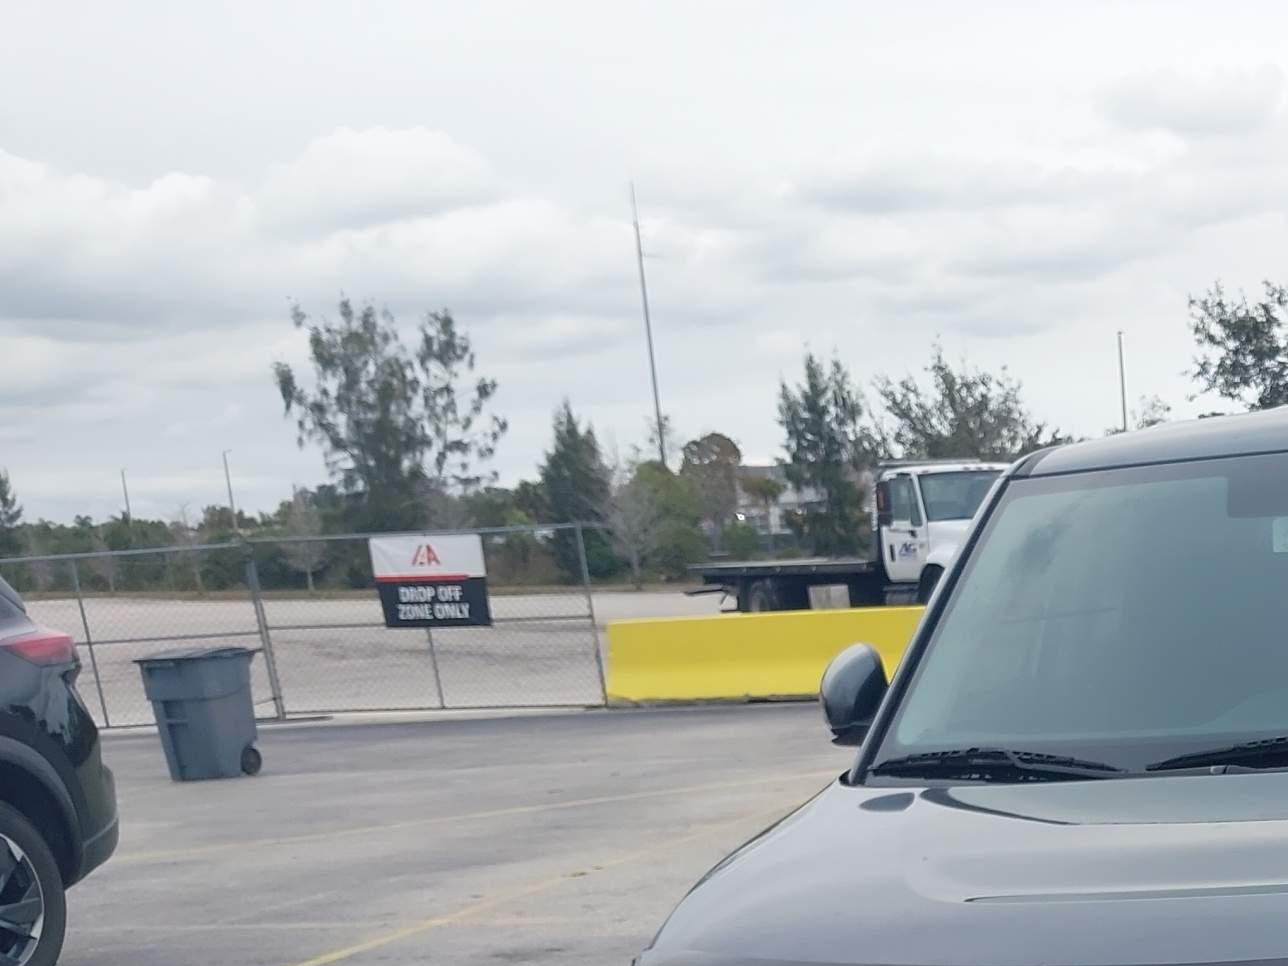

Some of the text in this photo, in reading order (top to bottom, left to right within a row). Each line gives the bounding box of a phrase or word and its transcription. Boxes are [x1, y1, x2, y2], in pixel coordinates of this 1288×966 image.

[398, 585, 463, 602] DROP OFF
[398, 603, 470, 620] ZONE ONLY
